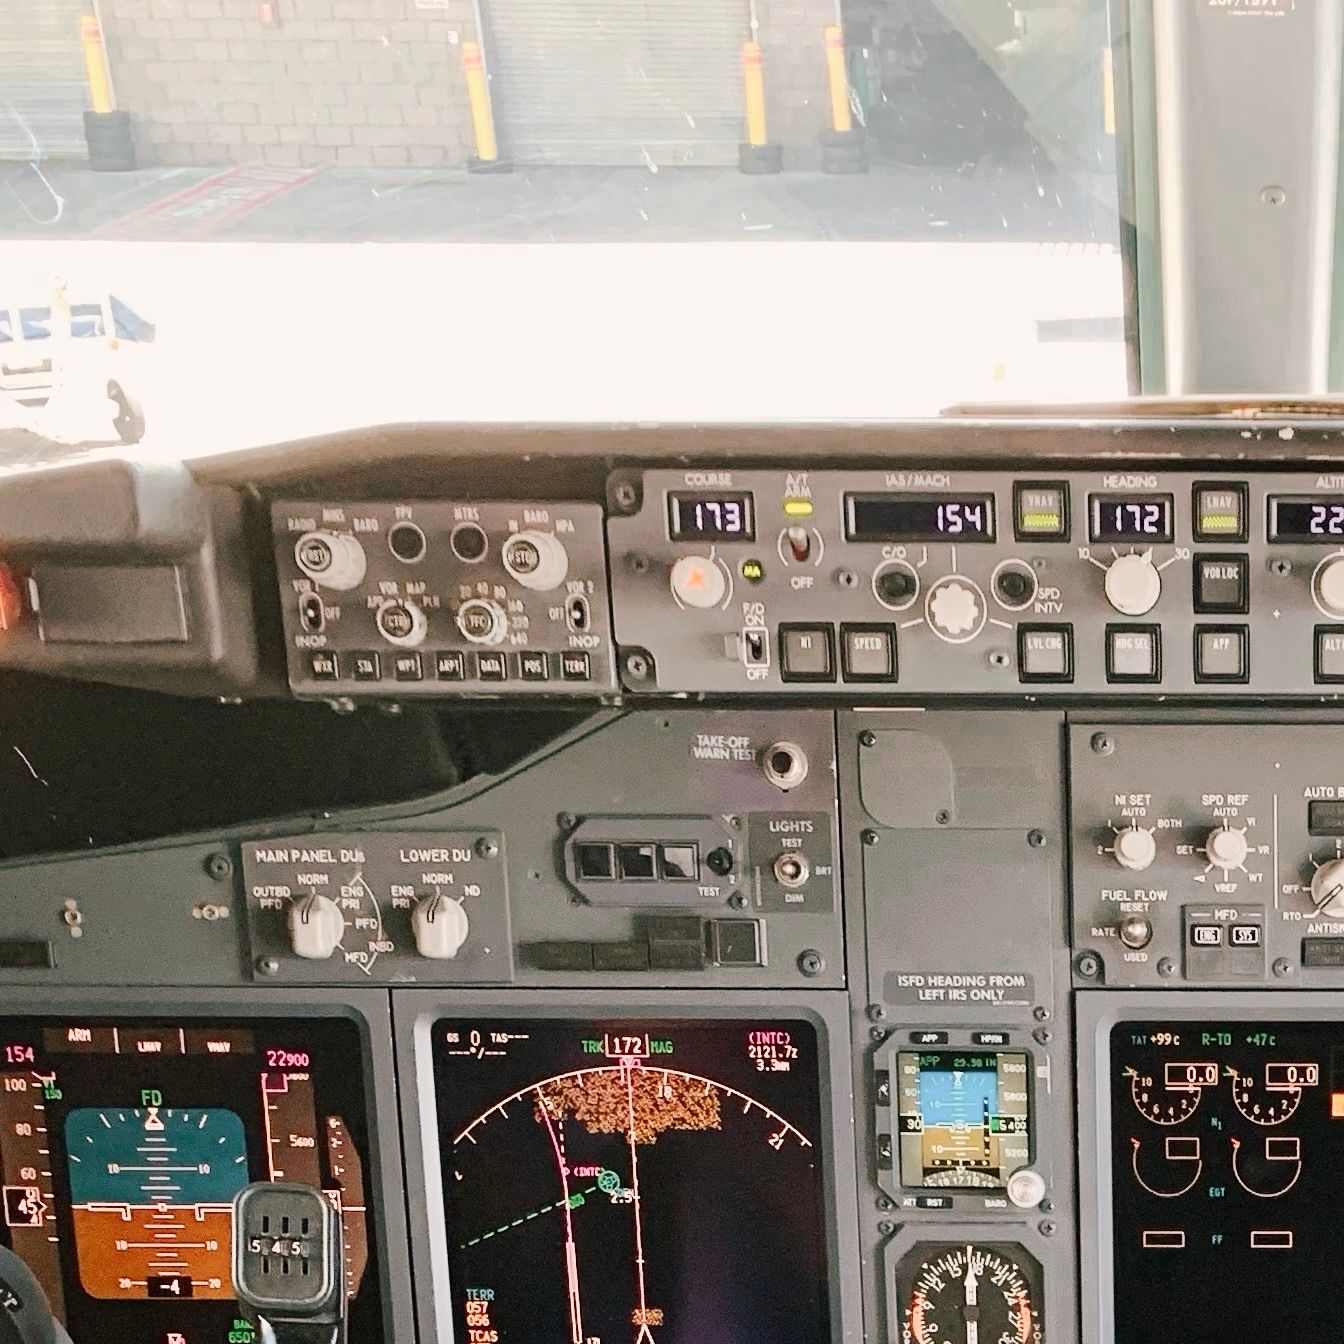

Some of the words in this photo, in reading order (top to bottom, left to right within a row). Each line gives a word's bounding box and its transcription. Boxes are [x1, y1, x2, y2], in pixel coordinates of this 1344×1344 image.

[684, 473, 732, 487] COURSE
[885, 474, 950, 487] IAS/MACH
[1103, 476, 1157, 488] HEADING
[696, 502, 741, 532] 173
[936, 504, 982, 532] 154
[1114, 505, 1159, 533] 172
[697, 736, 749, 748] TAKE-OFF
[694, 748, 730, 760] WARN
[733, 748, 757, 760] TEST
[1304, 786, 1332, 798] AUTO
[769, 820, 814, 834] LIGHTS
[256, 850, 288, 863] MAIN
[292, 850, 336, 863] PANEL
[339, 850, 365, 863] DUs
[400, 850, 447, 863] LOWER
[449, 850, 472, 863] DU
[298, 874, 329, 886] NORM
[253, 886, 291, 898] OUTBD
[1101, 890, 1129, 902] FUEL
[1134, 890, 1168, 902] FLOW
[898, 976, 925, 987] ISFD
[928, 976, 986, 987] HEADING
[989, 975, 1025, 987] FROM
[919, 989, 945, 1000] LEFT
[949, 989, 967, 1000] IRS
[970, 989, 1004, 1000] ONLY
[582, 1040, 604, 1053] TRK
[613, 1037, 642, 1053] 172
[651, 1041, 673, 1053] MAG
[6, 1045, 34, 1063] 154
[267, 1051, 309, 1067] 22900
[142, 1090, 162, 1105] FD
[466, 1288, 495, 1301] TERR
[469, 1330, 498, 1342] TCAS
